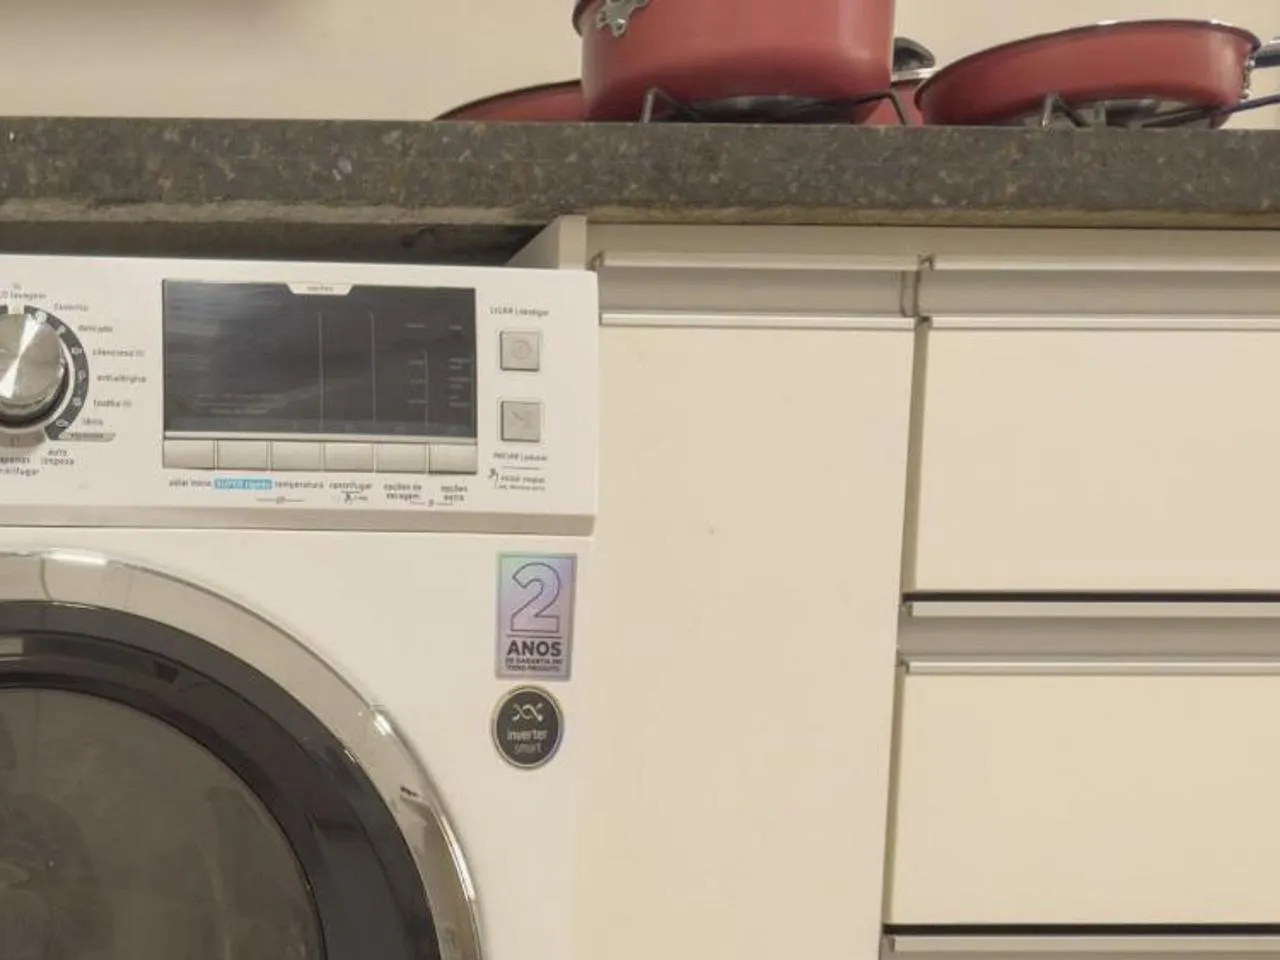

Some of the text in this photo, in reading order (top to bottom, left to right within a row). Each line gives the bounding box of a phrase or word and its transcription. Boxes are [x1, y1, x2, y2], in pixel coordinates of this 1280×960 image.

[510, 562, 562, 634] 2
[507, 640, 562, 657] ANOS
[507, 729, 548, 741] inverter
